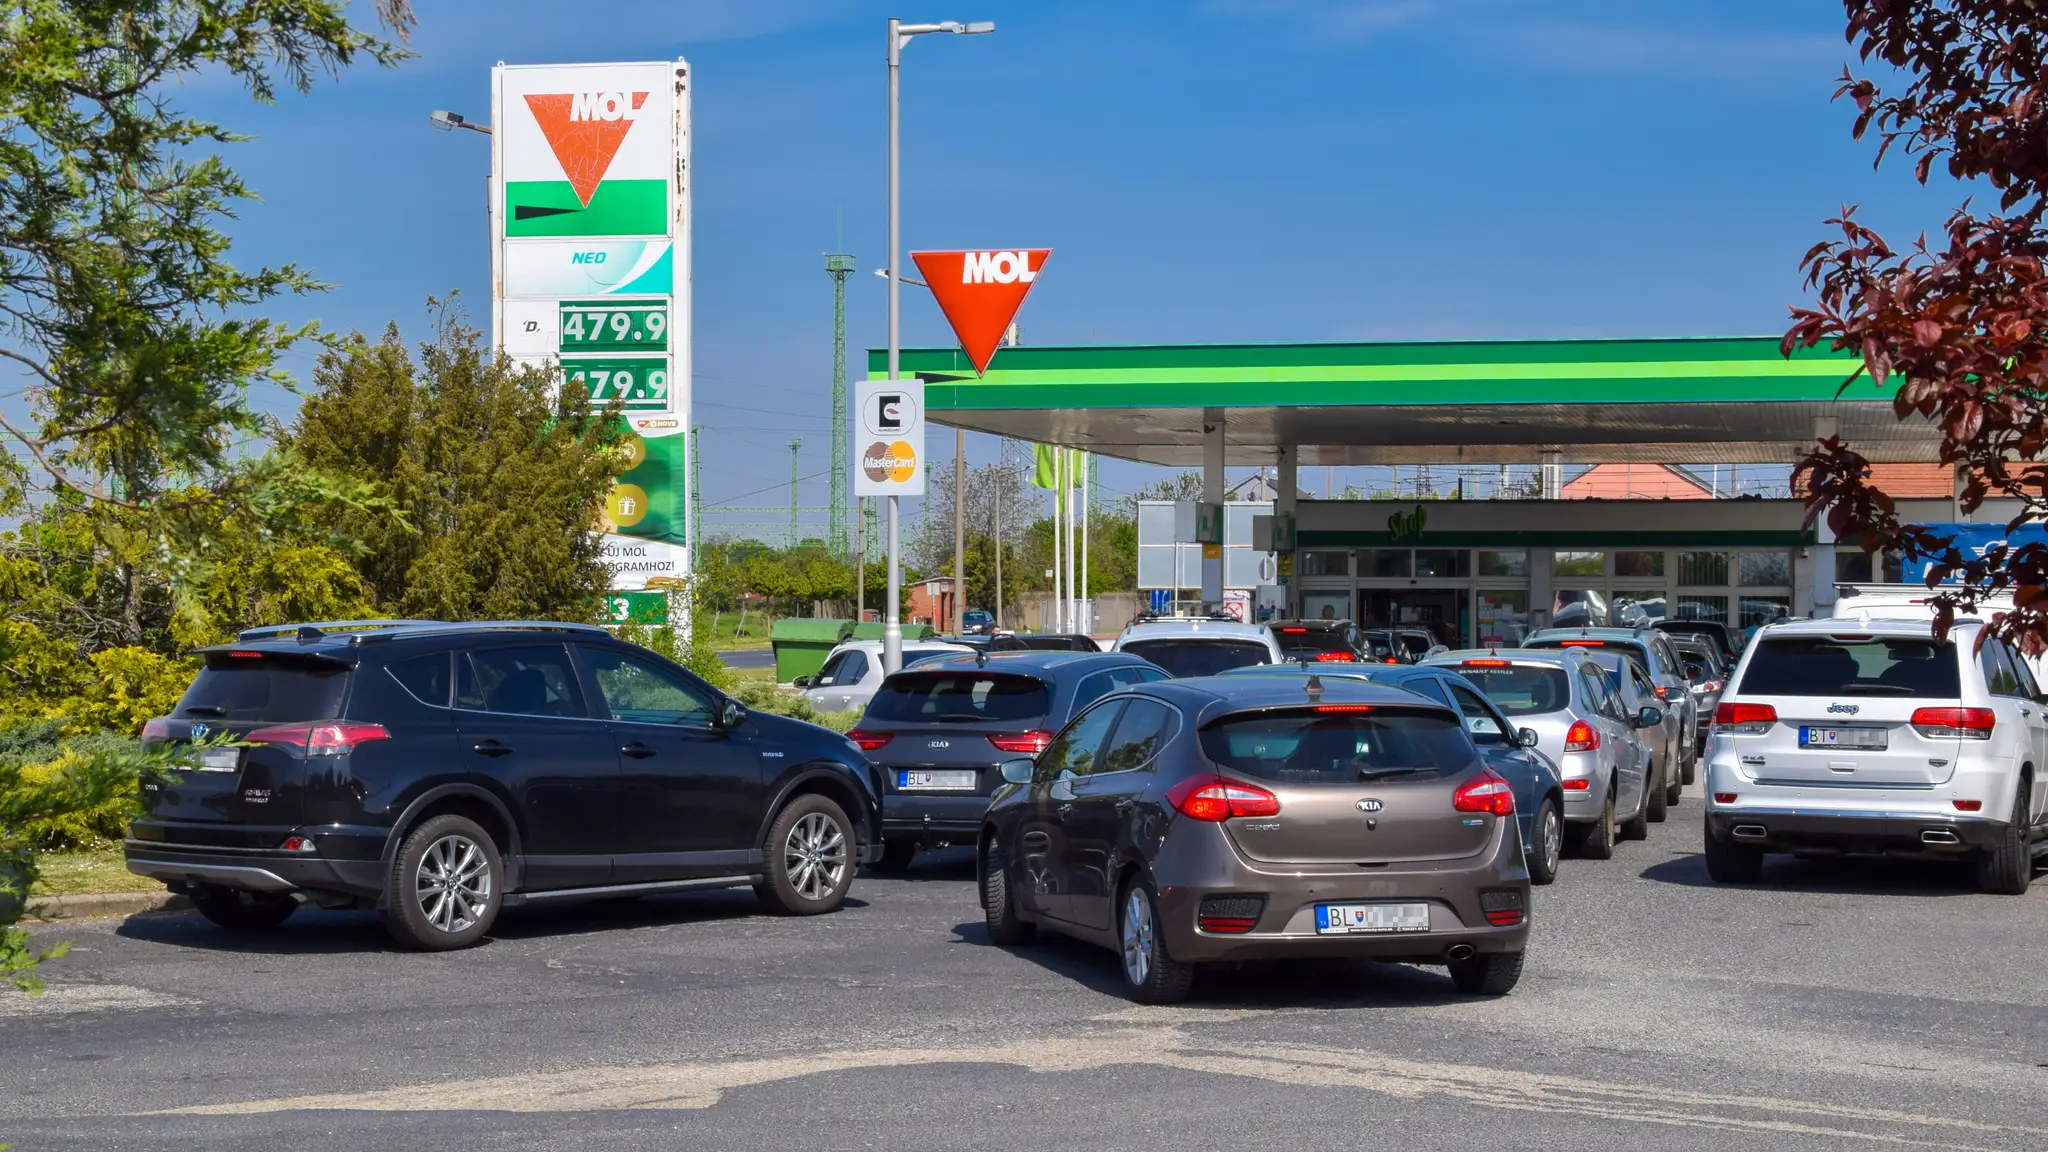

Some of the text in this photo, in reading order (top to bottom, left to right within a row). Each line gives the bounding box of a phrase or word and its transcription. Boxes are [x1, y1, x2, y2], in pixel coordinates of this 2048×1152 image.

[570, 92, 640, 122] MOL
[572, 252, 607, 264] NEO
[962, 252, 1037, 284] MOL
[564, 312, 666, 341] 479.9
[864, 457, 915, 468] MasterCard
[623, 547, 647, 557] MOL
[607, 561, 675, 572] OGRAMHOZ!
[1827, 702, 1860, 715] Jeep
[1810, 728, 1828, 742] BT
[908, 771, 924, 785] BL
[1358, 801, 1381, 810] KIA
[1330, 908, 1354, 927] BL
